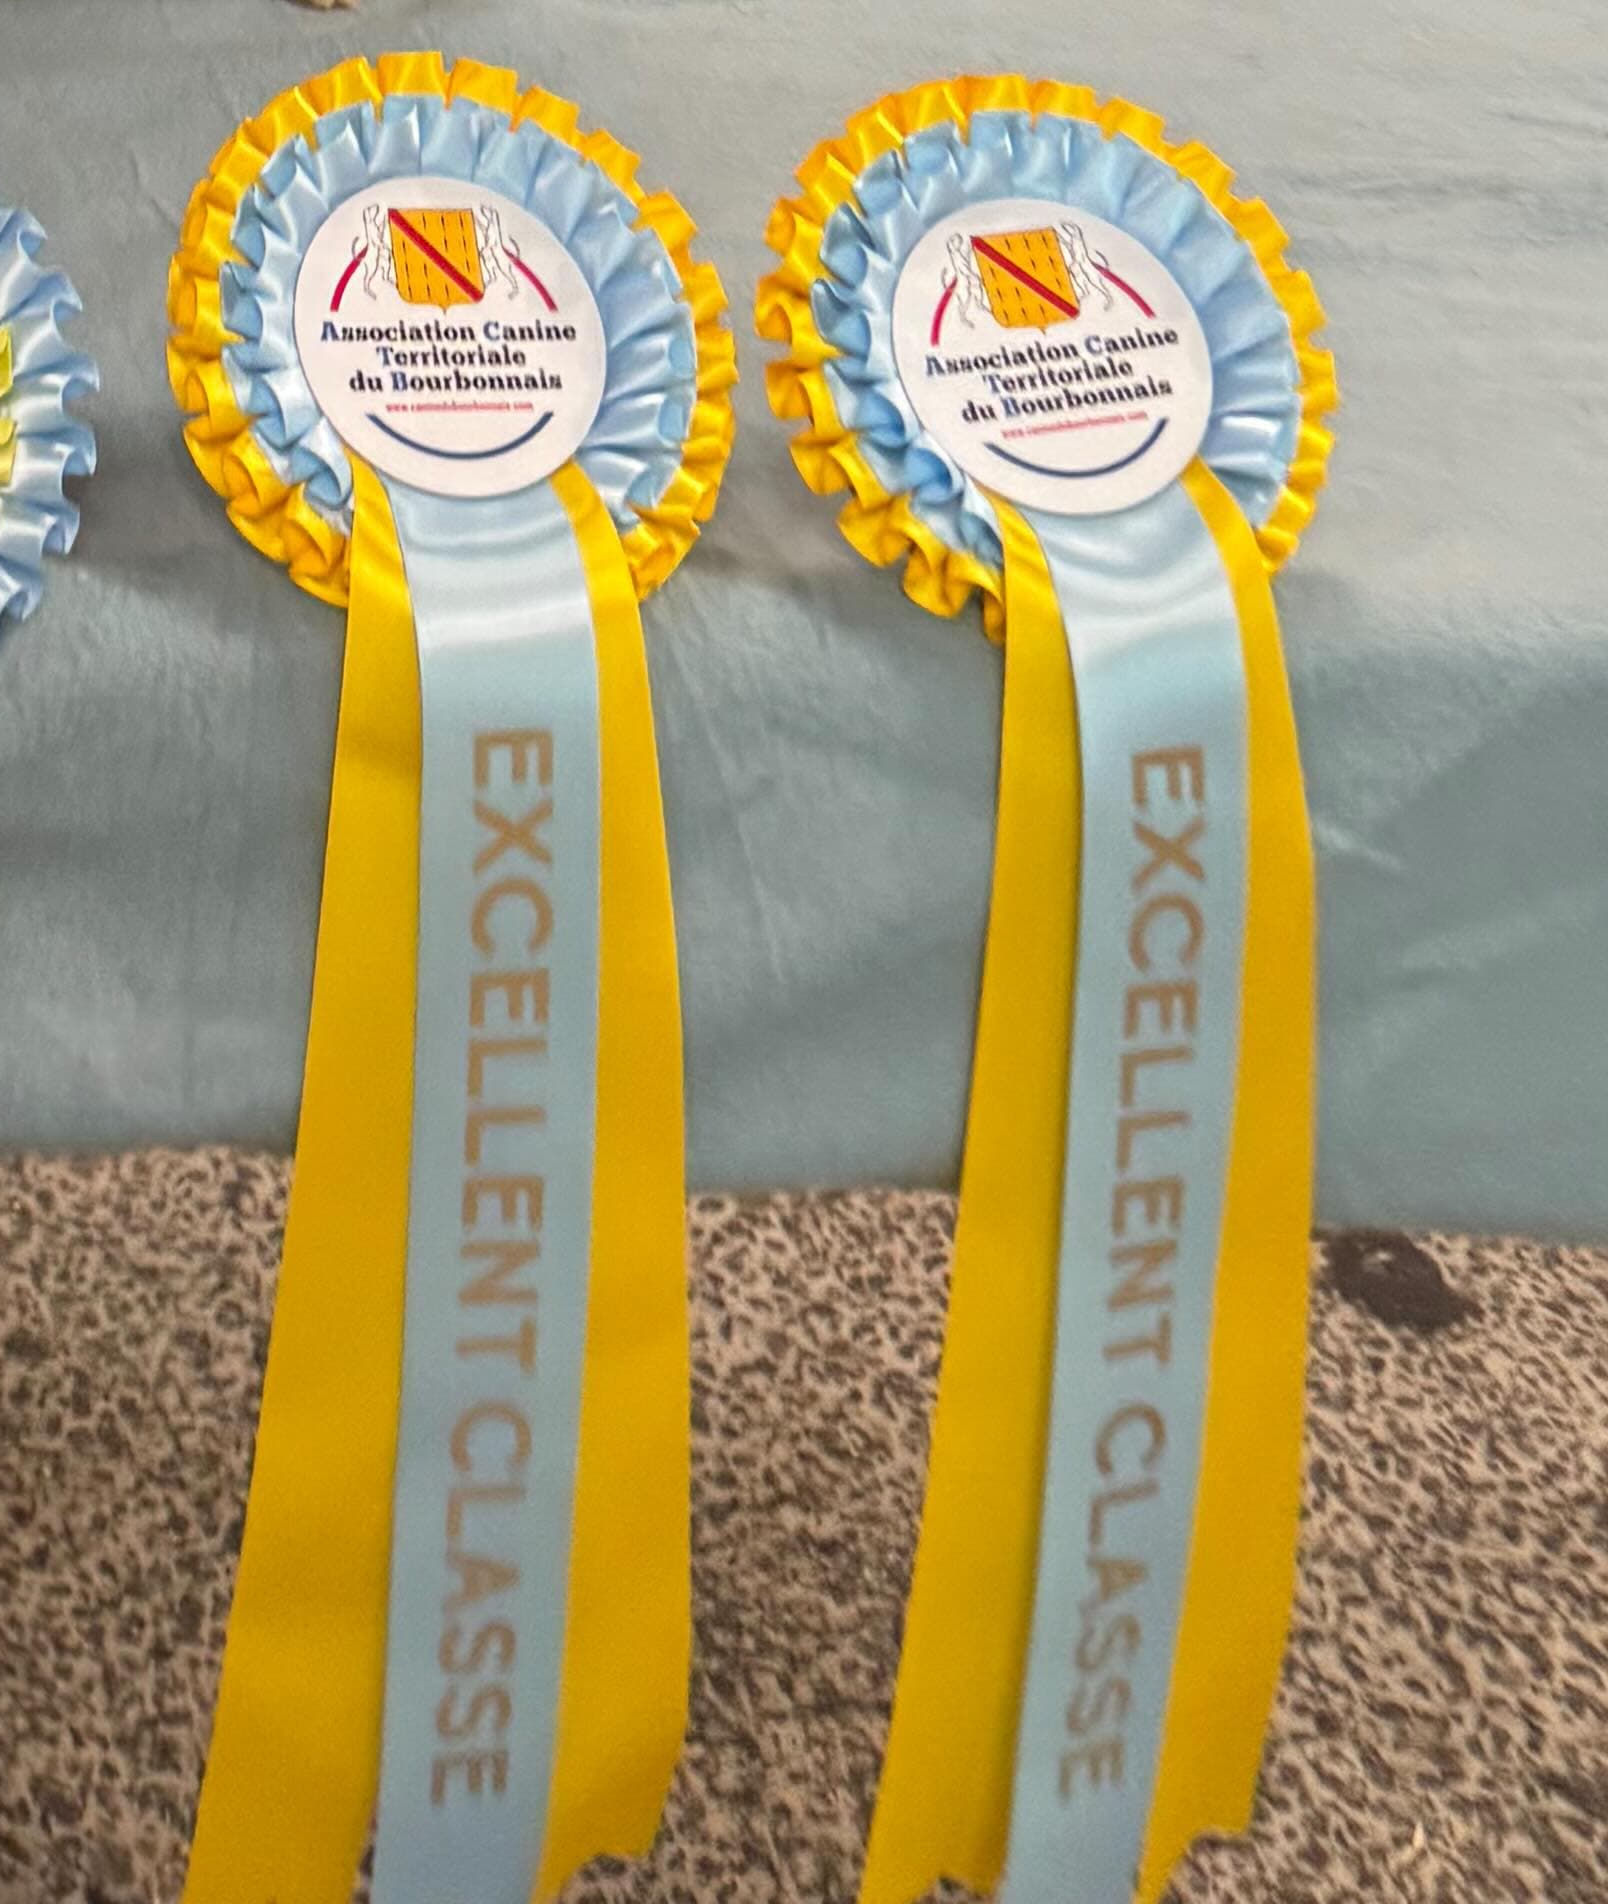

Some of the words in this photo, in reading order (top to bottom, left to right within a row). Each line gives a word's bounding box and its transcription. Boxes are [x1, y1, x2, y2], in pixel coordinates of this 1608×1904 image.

[320, 320, 476, 342] Association
[483, 320, 576, 342] Canine
[925, 341, 1079, 379] Association
[1084, 326, 1180, 355] Canine
[349, 370, 384, 392] du
[391, 369, 562, 393] Bourbonnais
[376, 345, 526, 368] Territoriale
[982, 357, 1135, 393] Territoriale
[961, 400, 999, 424] du
[1001, 376, 1174, 418] Bourbonnais
[454, 727, 555, 1378] EXCELLENT
[1101, 743, 1208, 1371] EXCELLENT
[430, 1398, 533, 1808] CLASSE
[1059, 1400, 1167, 1810] CLASSE
